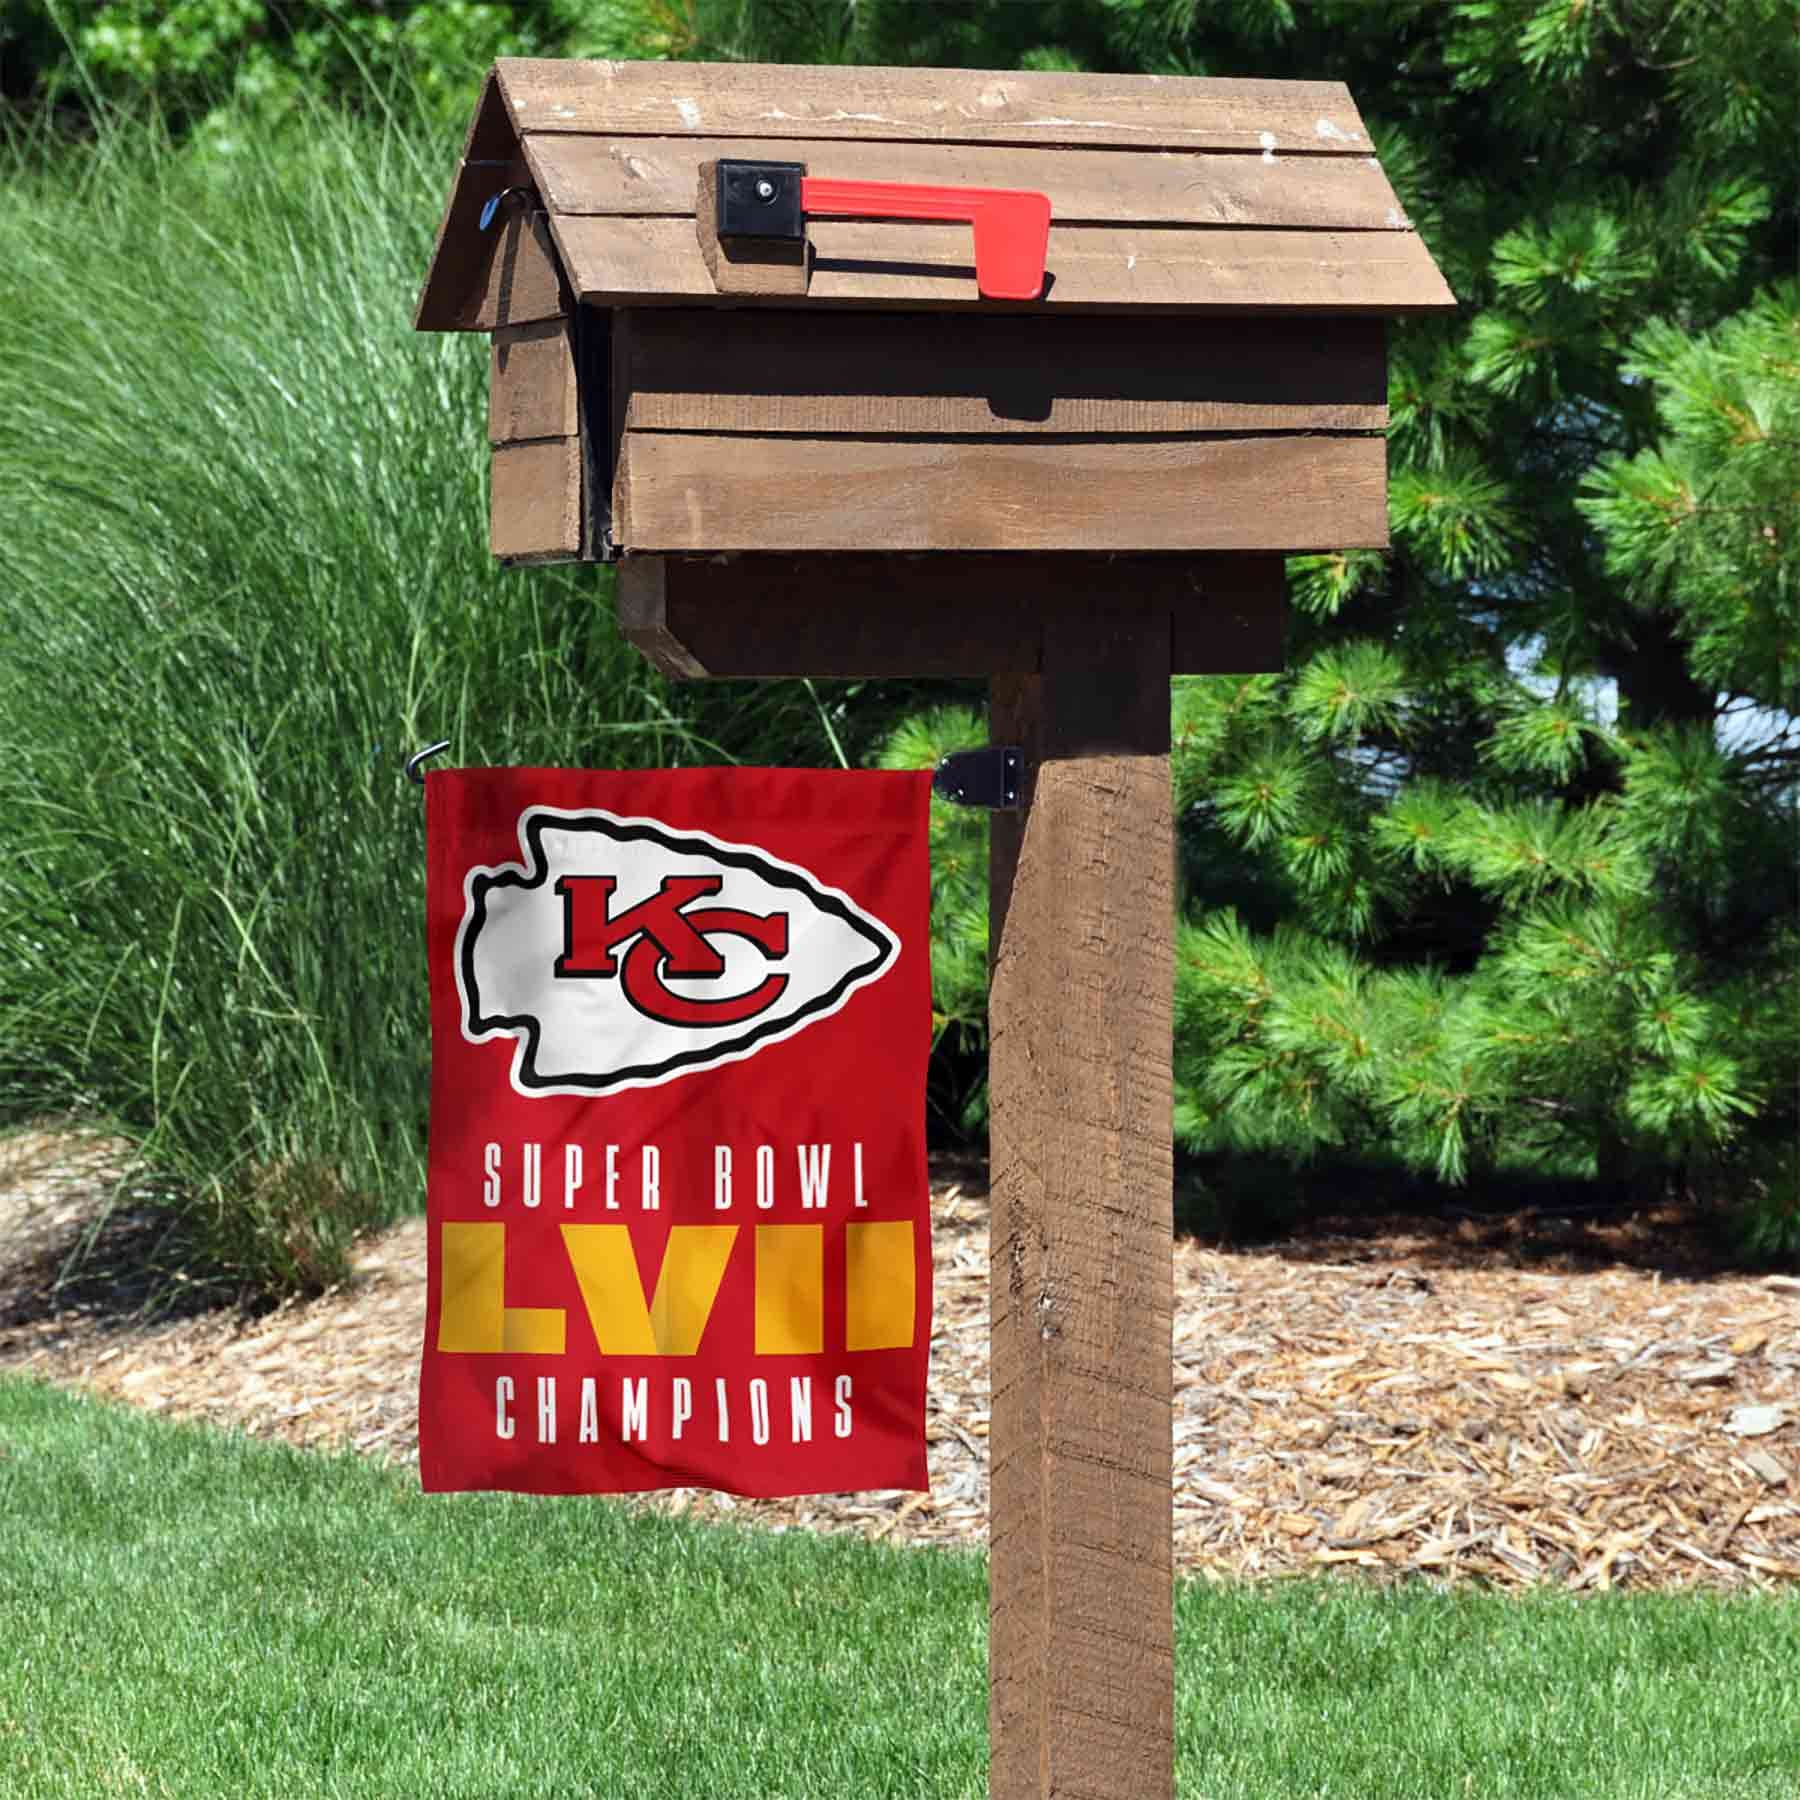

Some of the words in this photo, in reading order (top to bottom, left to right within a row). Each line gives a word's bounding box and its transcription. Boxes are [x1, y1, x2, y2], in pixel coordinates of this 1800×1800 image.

[554, 875, 789, 1028] KC
[483, 1142, 661, 1210] SUPER
[714, 1142, 868, 1210] BOWL
[437, 1220, 916, 1356] LVII
[495, 1375, 853, 1446] CHAMPIONS
